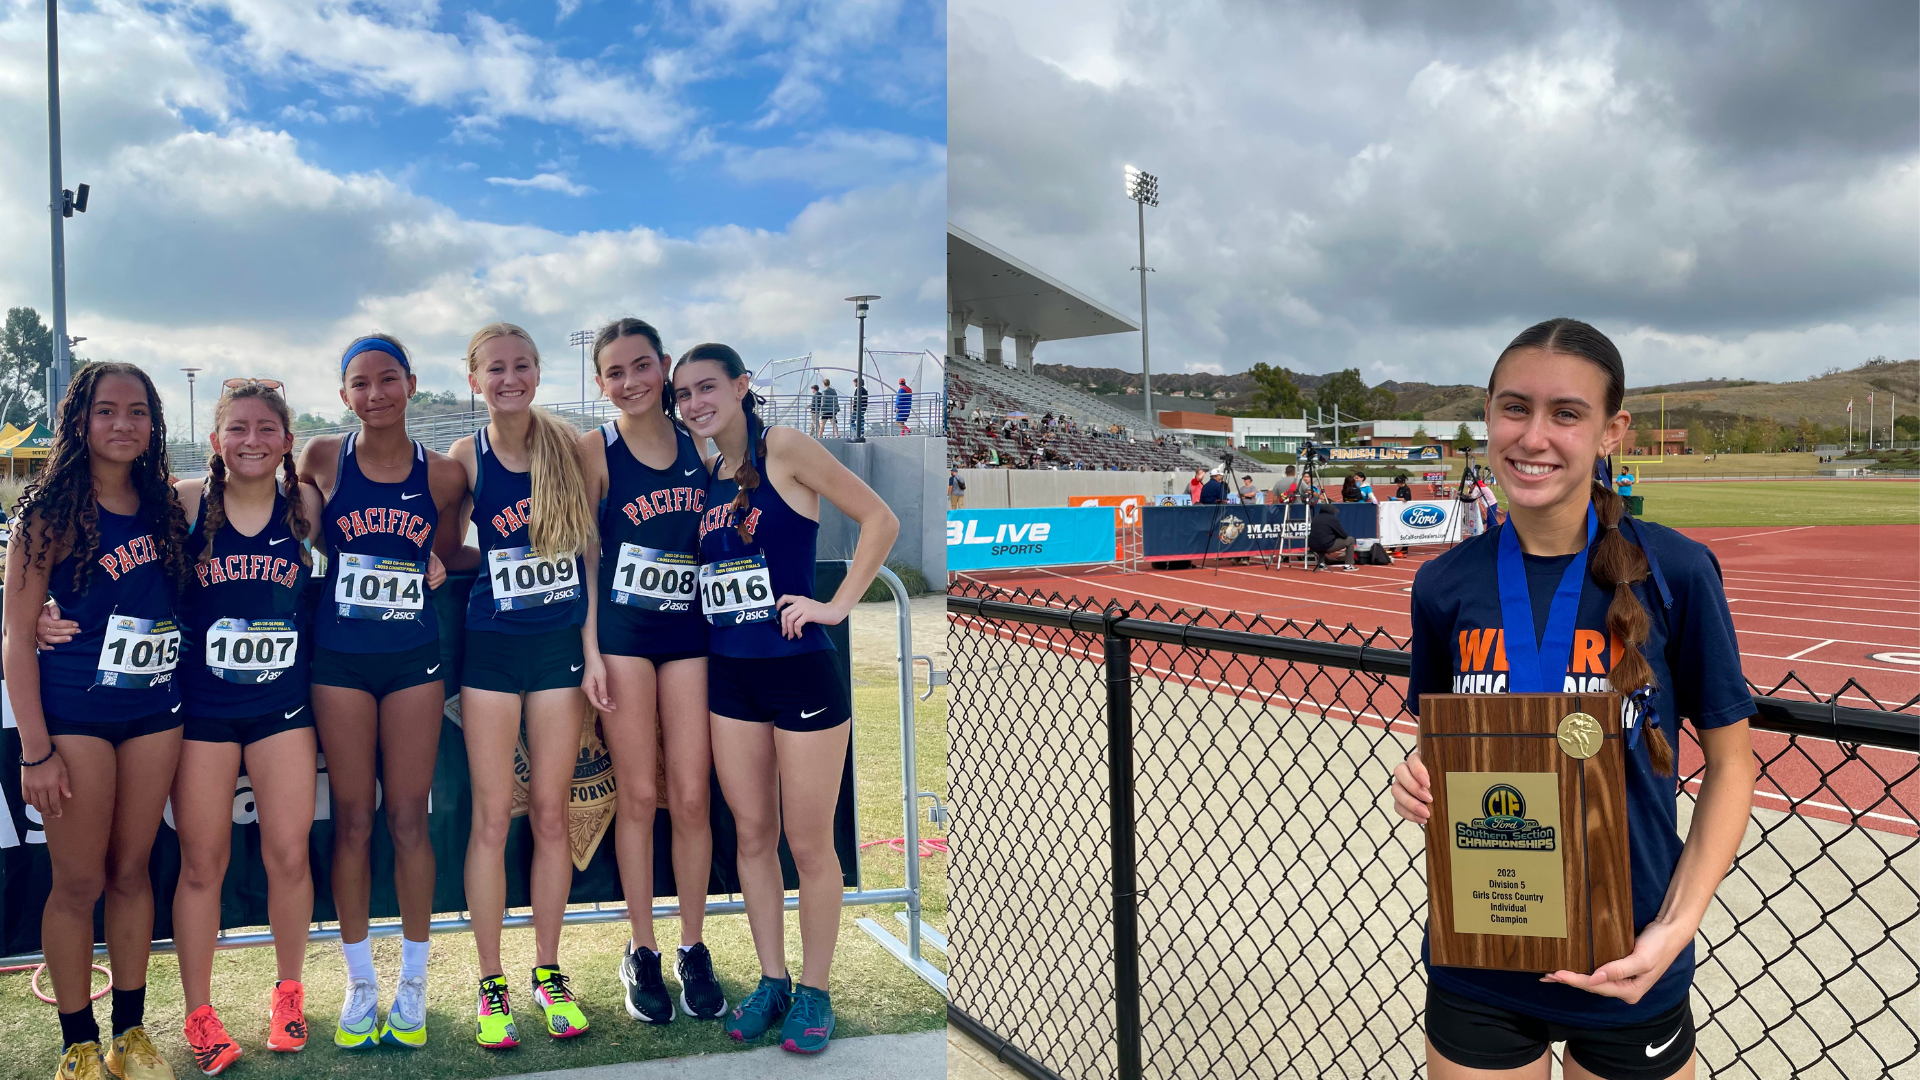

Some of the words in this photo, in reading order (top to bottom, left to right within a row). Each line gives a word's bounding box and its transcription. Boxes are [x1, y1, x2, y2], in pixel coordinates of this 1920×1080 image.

[1329, 448, 1376, 460] FINISH
[1380, 448, 1410, 460] LINE
[622, 487, 704, 526] PACIFIC
[1409, 507, 1438, 526] Ford
[337, 507, 431, 548] PACIFICA
[991, 543, 1043, 556] SPORTS
[194, 554, 299, 589] PACIFICA
[495, 557, 573, 592] 1009
[620, 563, 695, 594] 1008
[341, 573, 421, 603] 1014
[702, 575, 768, 608] 1016
[108, 637, 179, 668] 1015
[211, 637, 294, 664] 1007
[1488, 789, 1520, 817] CIF
[1458, 824, 1508, 840] Southern
[1512, 828, 1553, 840] Section
[1491, 817, 1518, 829] Ford
[1458, 837, 1554, 849] CHAMPIONSHIPS
[1497, 868, 1516, 877] 2023
[1489, 880, 1518, 889] Division
[1520, 881, 1526, 889] 5
[1473, 891, 1490, 899] Girls
[1492, 891, 1513, 900] Cross
[1515, 892, 1544, 903] Country
[1491, 903, 1526, 912] Individual
[1491, 914, 1528, 925] Champion
